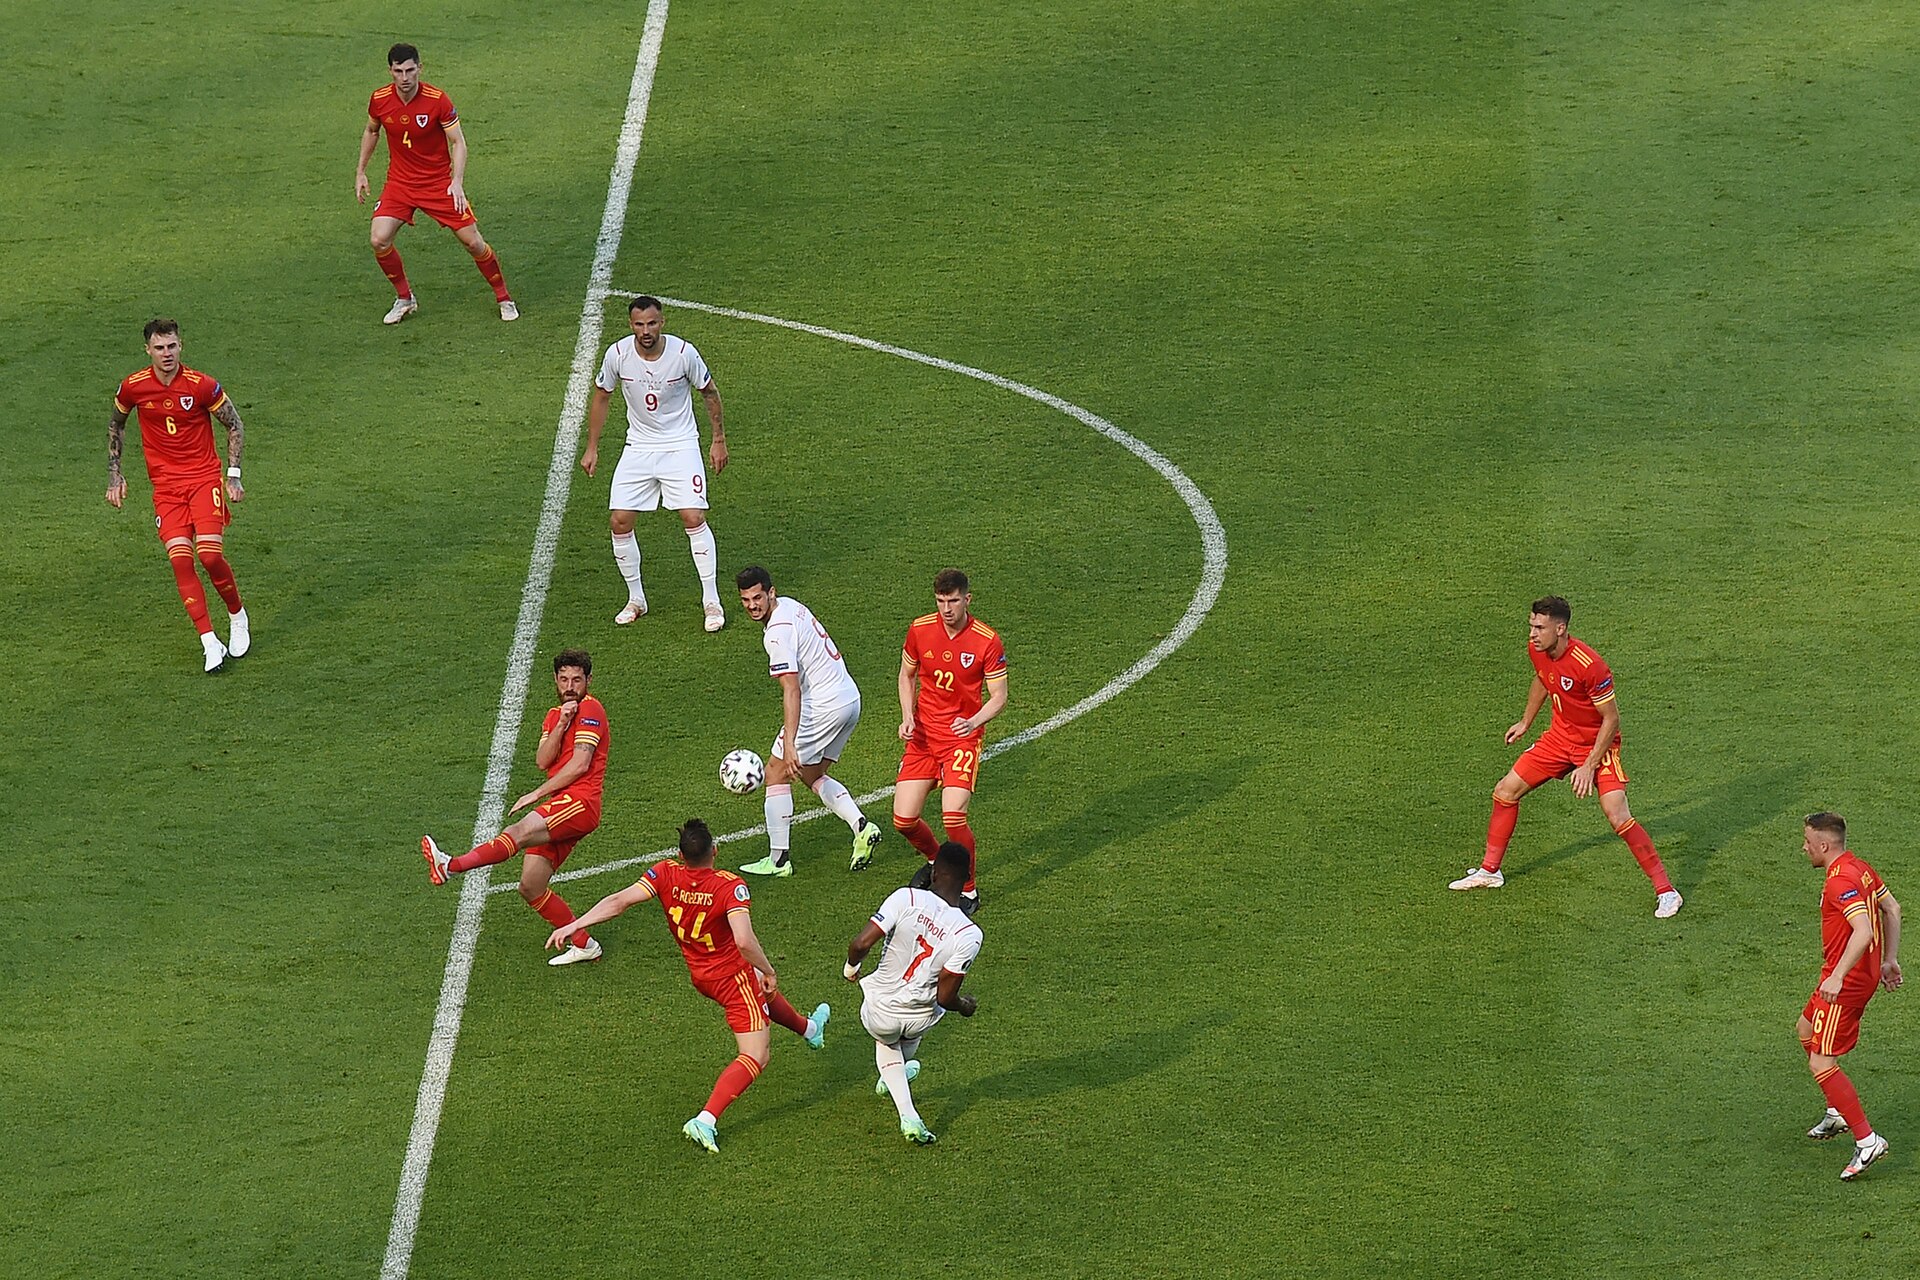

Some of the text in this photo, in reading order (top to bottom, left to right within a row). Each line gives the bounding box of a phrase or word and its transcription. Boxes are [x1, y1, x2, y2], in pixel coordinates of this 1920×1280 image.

[402, 130, 412, 149] 4
[645, 393, 658, 412] 9
[165, 416, 177, 435] 6
[692, 474, 704, 494] 9
[212, 487, 221, 507] 6
[933, 669, 954, 692] 22
[952, 749, 974, 773] 22
[551, 794, 573, 805] 7
[679, 889, 714, 906] ROBERTS
[668, 906, 716, 952] 14
[902, 934, 934, 983] 7
